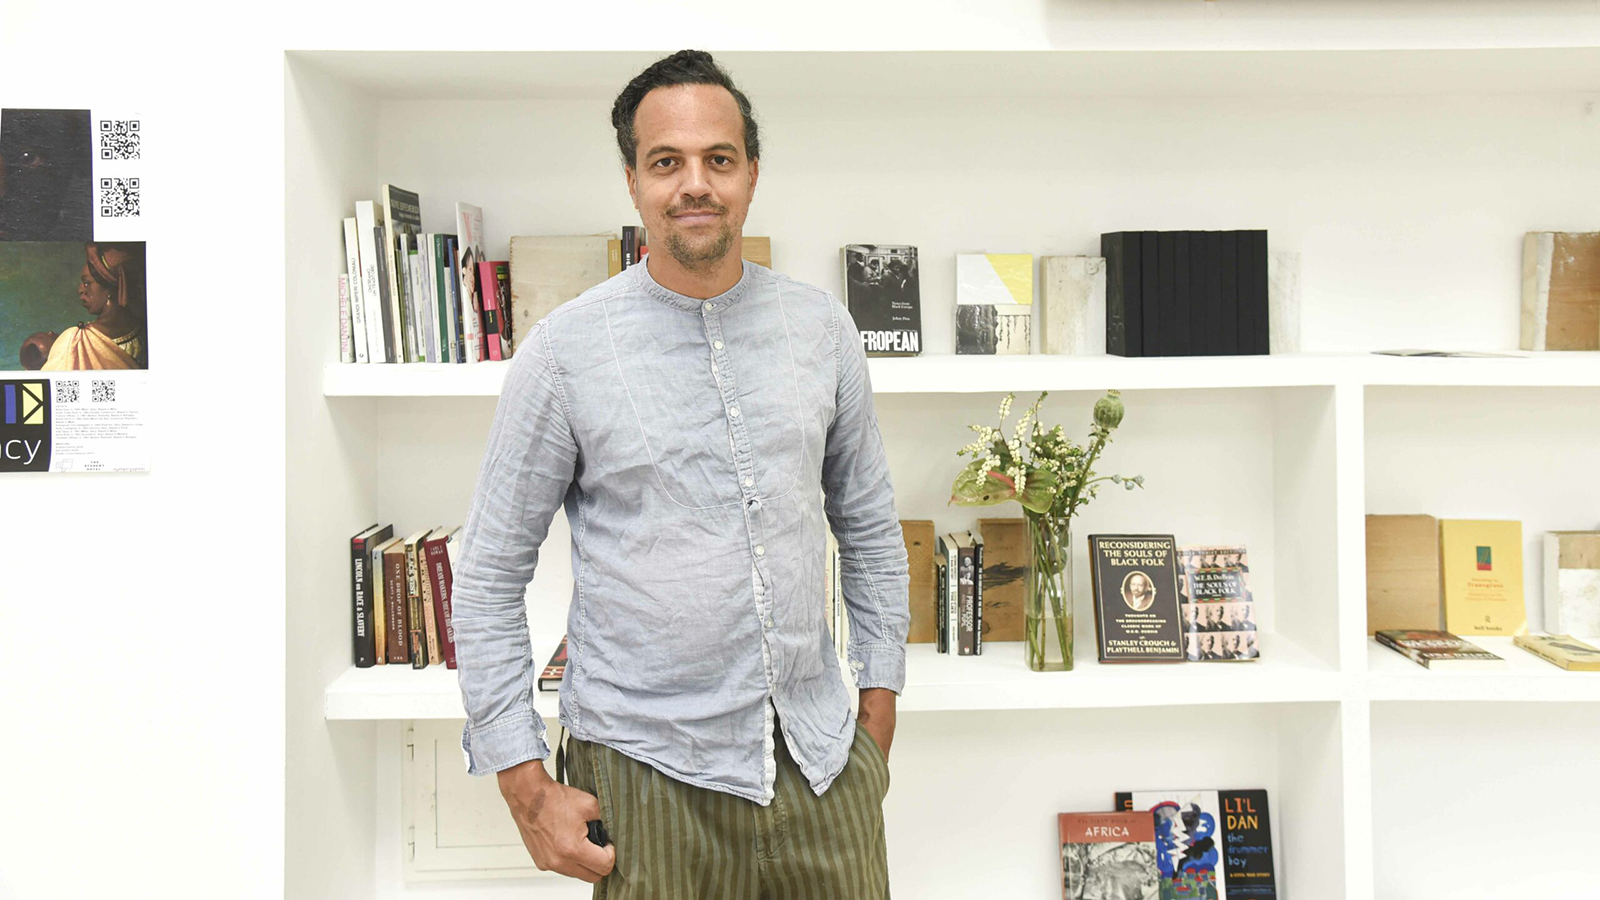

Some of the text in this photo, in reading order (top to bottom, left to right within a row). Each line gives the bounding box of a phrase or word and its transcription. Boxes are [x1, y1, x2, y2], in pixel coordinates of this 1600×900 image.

[339, 278, 347, 315] MICHELE
[355, 558, 363, 582] LINCOLN
[436, 562, 444, 580] DREAM
[442, 601, 450, 618] DREAM
[397, 606, 402, 616] OF
[1225, 798, 1256, 813] LI'L
[1227, 815, 1258, 830] DAN
[1085, 826, 1129, 837] AFRICA
[1227, 833, 1244, 843] the
[1228, 845, 1268, 854] drummer
[1228, 856, 1247, 867] boy
